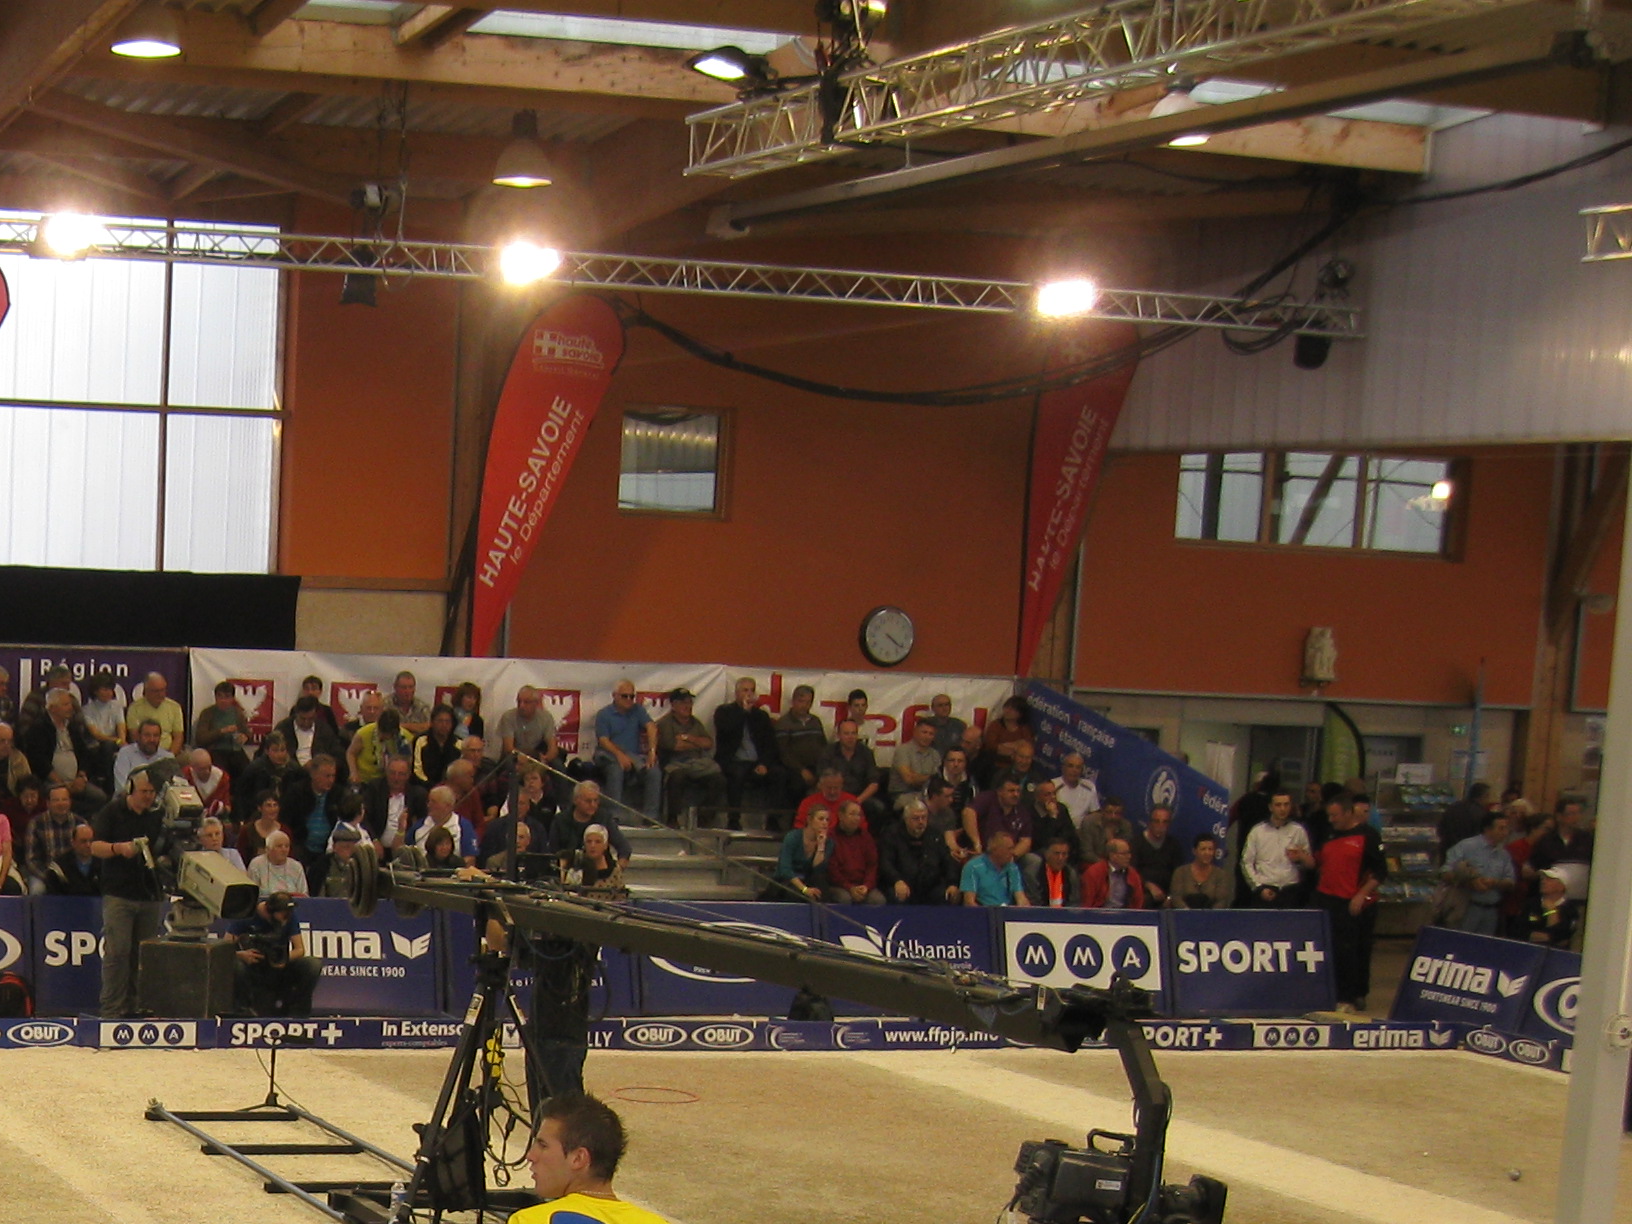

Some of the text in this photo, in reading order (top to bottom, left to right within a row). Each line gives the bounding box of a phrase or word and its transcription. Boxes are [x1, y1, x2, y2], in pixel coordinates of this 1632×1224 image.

[479, 395, 572, 587] HAUTE-SAVOIE
[299, 922, 382, 960] ima
[897, 940, 972, 959] Albanais
[1177, 940, 1325, 974] SPORT+
[349, 965, 379, 977] SINCE
[381, 966, 406, 977] 1900
[1410, 953, 1493, 996] erima
[20, 1026, 61, 1041] OBUT
[382, 1021, 398, 1037] In
[636, 1027, 677, 1043] OBUT
[703, 1027, 743, 1043] OBUT
[1142, 1026, 1223, 1048] PORT+
[1353, 1025, 1425, 1048] erima
[1474, 1032, 1499, 1049] OBUT
[1516, 1041, 1541, 1059] OBUT
